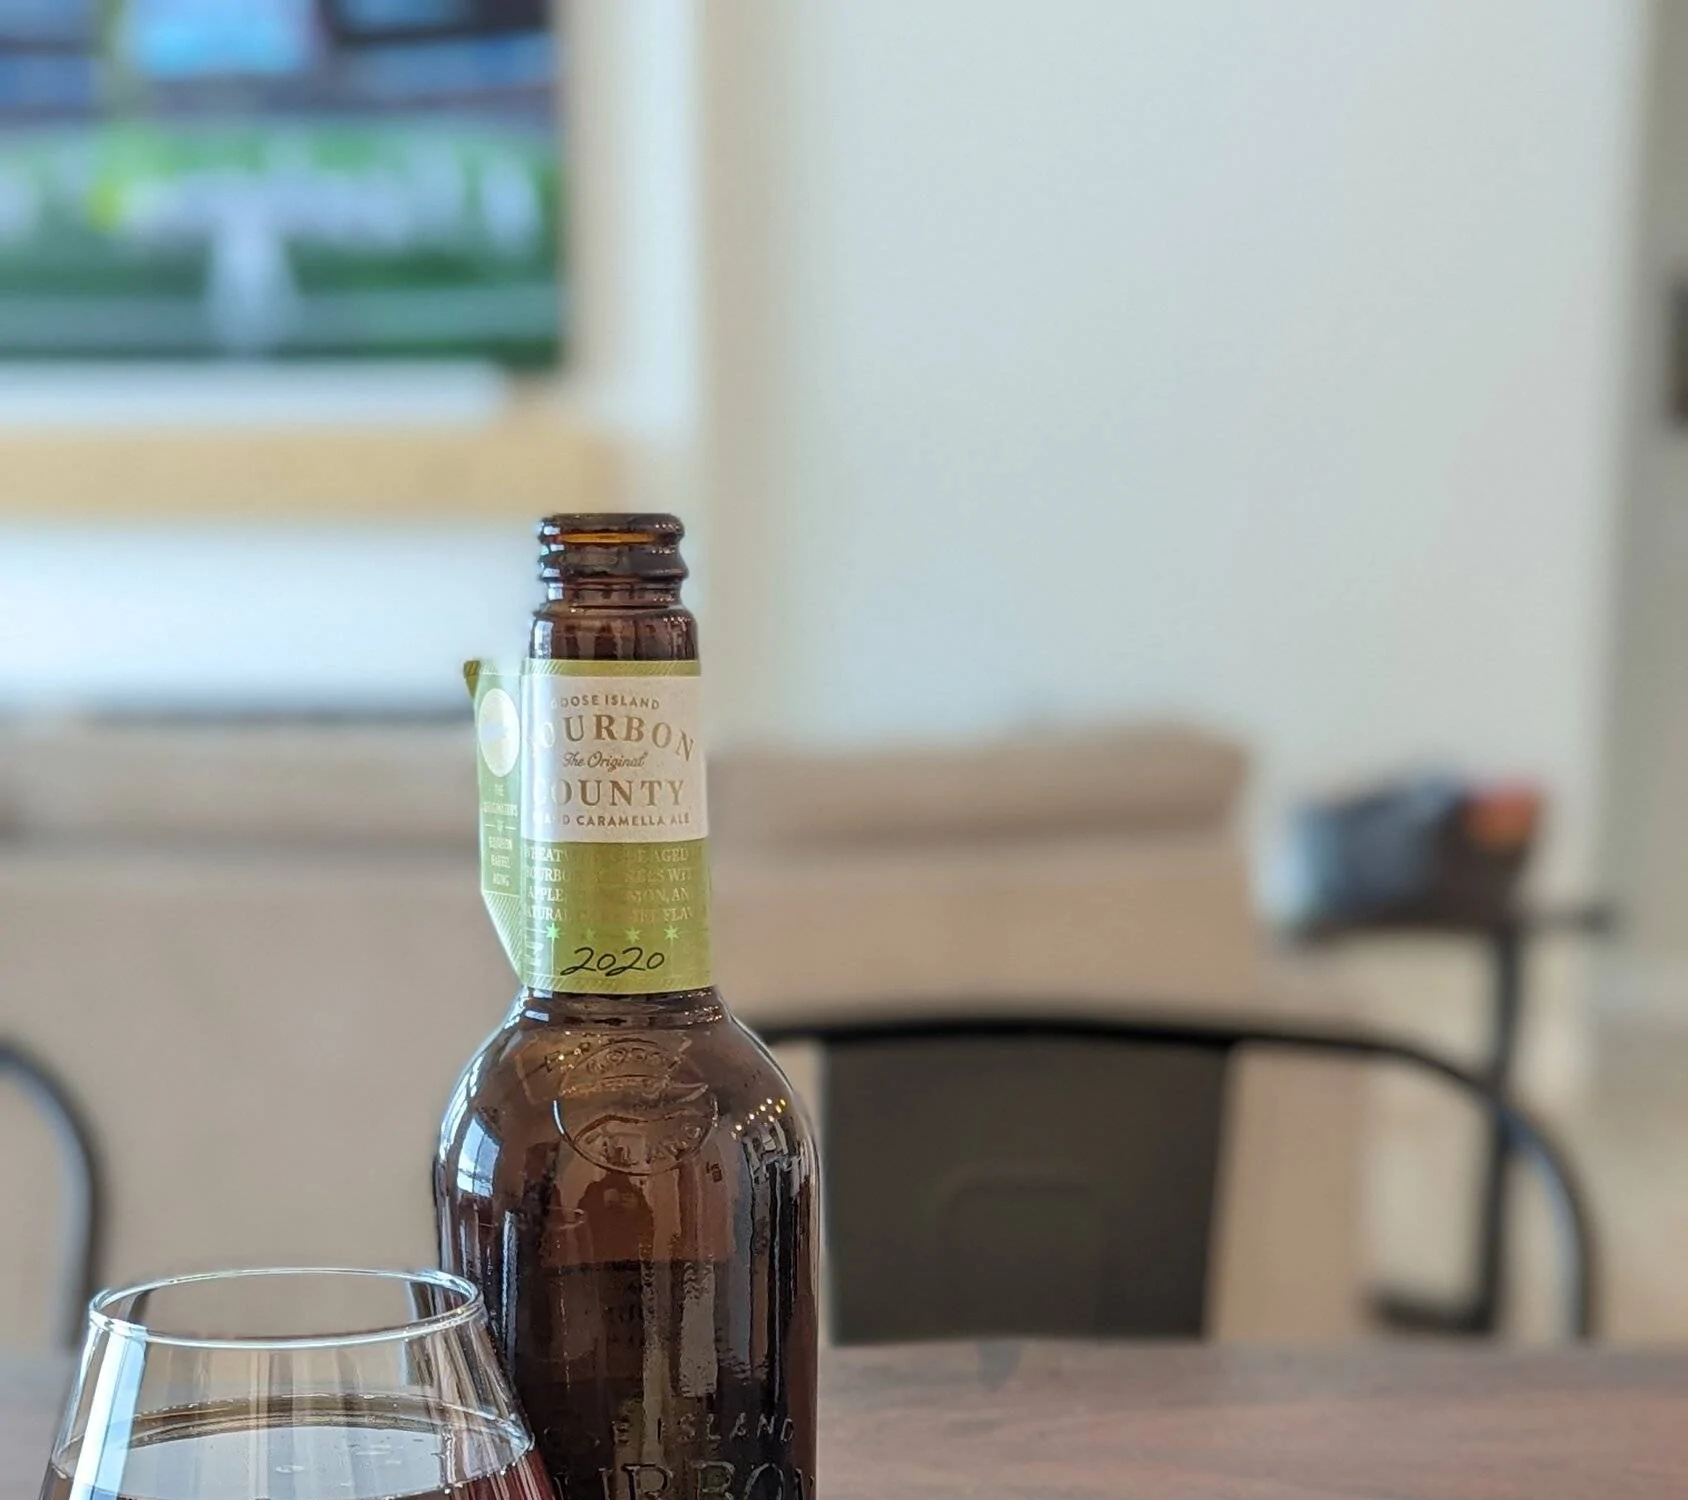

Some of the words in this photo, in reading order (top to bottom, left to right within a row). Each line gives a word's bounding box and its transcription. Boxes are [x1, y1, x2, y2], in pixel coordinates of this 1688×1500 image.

[551, 695, 599, 710] OOSE
[605, 695, 659, 710] ISLAND
[536, 713, 694, 762] OURBON
[562, 752, 585, 768] The
[587, 750, 649, 773] Original
[535, 779, 684, 807] OUNTY
[576, 815, 666, 827] CARAMELLA
[670, 813, 690, 825] ALE
[560, 946, 665, 977] 2020
[657, 1412, 794, 1445] ISLAND
